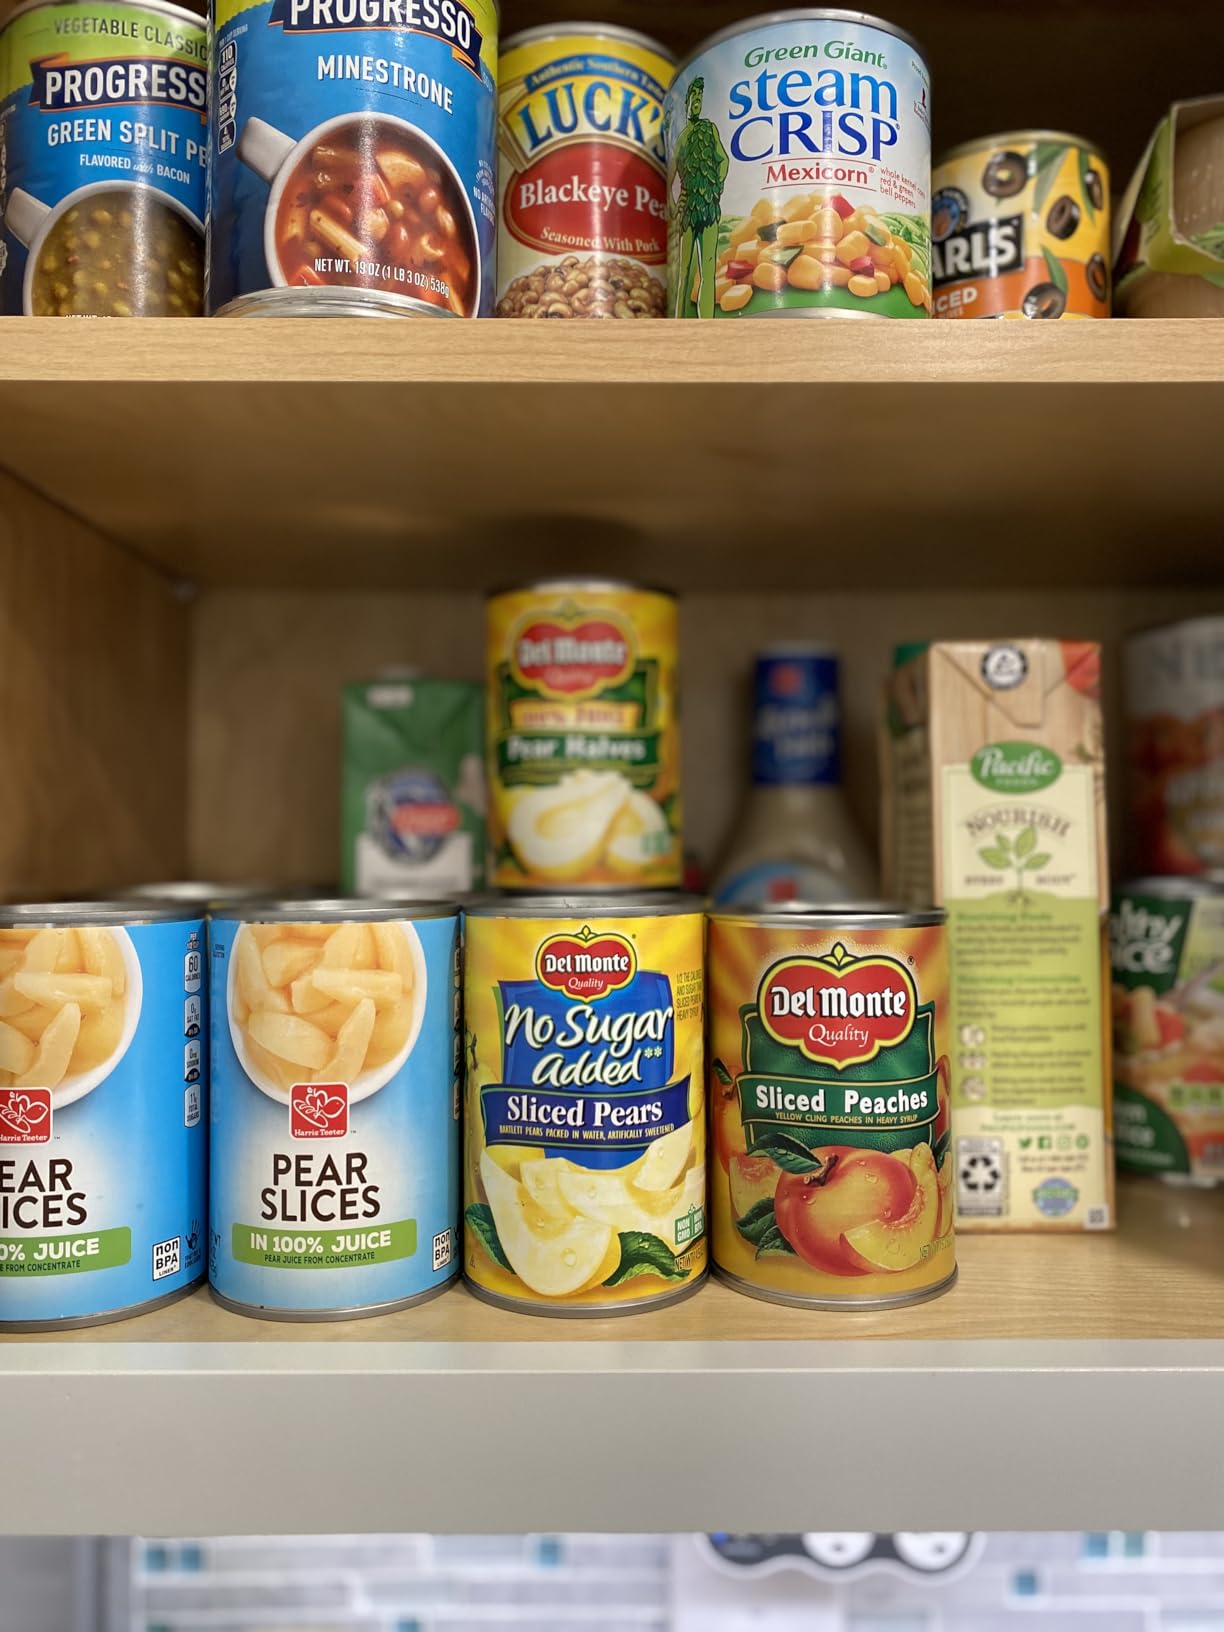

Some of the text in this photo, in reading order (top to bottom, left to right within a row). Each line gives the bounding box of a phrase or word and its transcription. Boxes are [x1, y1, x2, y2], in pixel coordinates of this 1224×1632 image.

[291, 0, 471, 49] PROGRESSO
[55, 17, 208, 61] VEGETABLE CLASSIC
[744, 40, 886, 69] Green Giant
[46, 64, 206, 107] PROGRESS
[317, 55, 454, 114] MINESTRONE
[728, 68, 898, 121] steam
[48, 118, 111, 146] GREEN
[120, 121, 180, 154] SPLIT
[186, 138, 207, 168] PE
[730, 110, 898, 162] CRISP
[80, 153, 131, 170] FLAVORED
[157, 164, 190, 185] BACON
[766, 162, 868, 185] Mexicorn
[880, 167, 900, 181] whole
[520, 175, 629, 212] Blackeye
[634, 185, 669, 221] Pea
[880, 177, 892, 187] red
[899, 185, 914, 199] green
[880, 184, 893, 197] bell
[540, 226, 660, 253] Seasoned With Pork
[315, 258, 333, 272] NET
[334, 259, 352, 273] WT.
[355, 261, 366, 275] 19
[368, 262, 380, 277] OZ
[394, 267, 405, 282] LB
[407, 270, 413, 283] 3
[977, 746, 1055, 780] Pacific
[188, 955, 199, 973] 60
[545, 954, 629, 973] Del Monte
[568, 977, 604, 990] Quality
[771, 986, 907, 1018] Del Monte
[504, 1003, 675, 1057] No Sugar
[808, 1023, 869, 1048] Quality
[507, 1094, 663, 1127] Sliced Pears
[755, 1085, 928, 1114] Sliced Peaches
[775, 1111, 918, 1124] YELLOW CLING PEACHES IN HEAVY SYRUP
[294, 1129, 319, 1137] Harris
[499, 1125, 522, 1135] BARTLETT
[525, 1126, 543, 1136] PEARS
[546, 1127, 569, 1138] PACKED
[572, 1128, 580, 1139] IN
[583, 1129, 606, 1141] WATER,
[645, 1123, 674, 1137] SWEETENED
[0, 1158, 73, 1193] EAR
[273, 1152, 367, 1187] PEAR
[2, 1192, 88, 1229] ICES
[261, 1185, 381, 1222] SLICES
[0, 1237, 100, 1261] 0% JUICE
[156, 1239, 178, 1256] non
[250, 1230, 391, 1254] IN 100% JUICE
[435, 1231, 449, 1248] non
[435, 1244, 449, 1260] BPA
[6, 1260, 80, 1272] FROM CONCENTRATE
[156, 1253, 178, 1270] BPA
[264, 1252, 375, 1264] PEAR JUICE FROM CONCENTRATE
